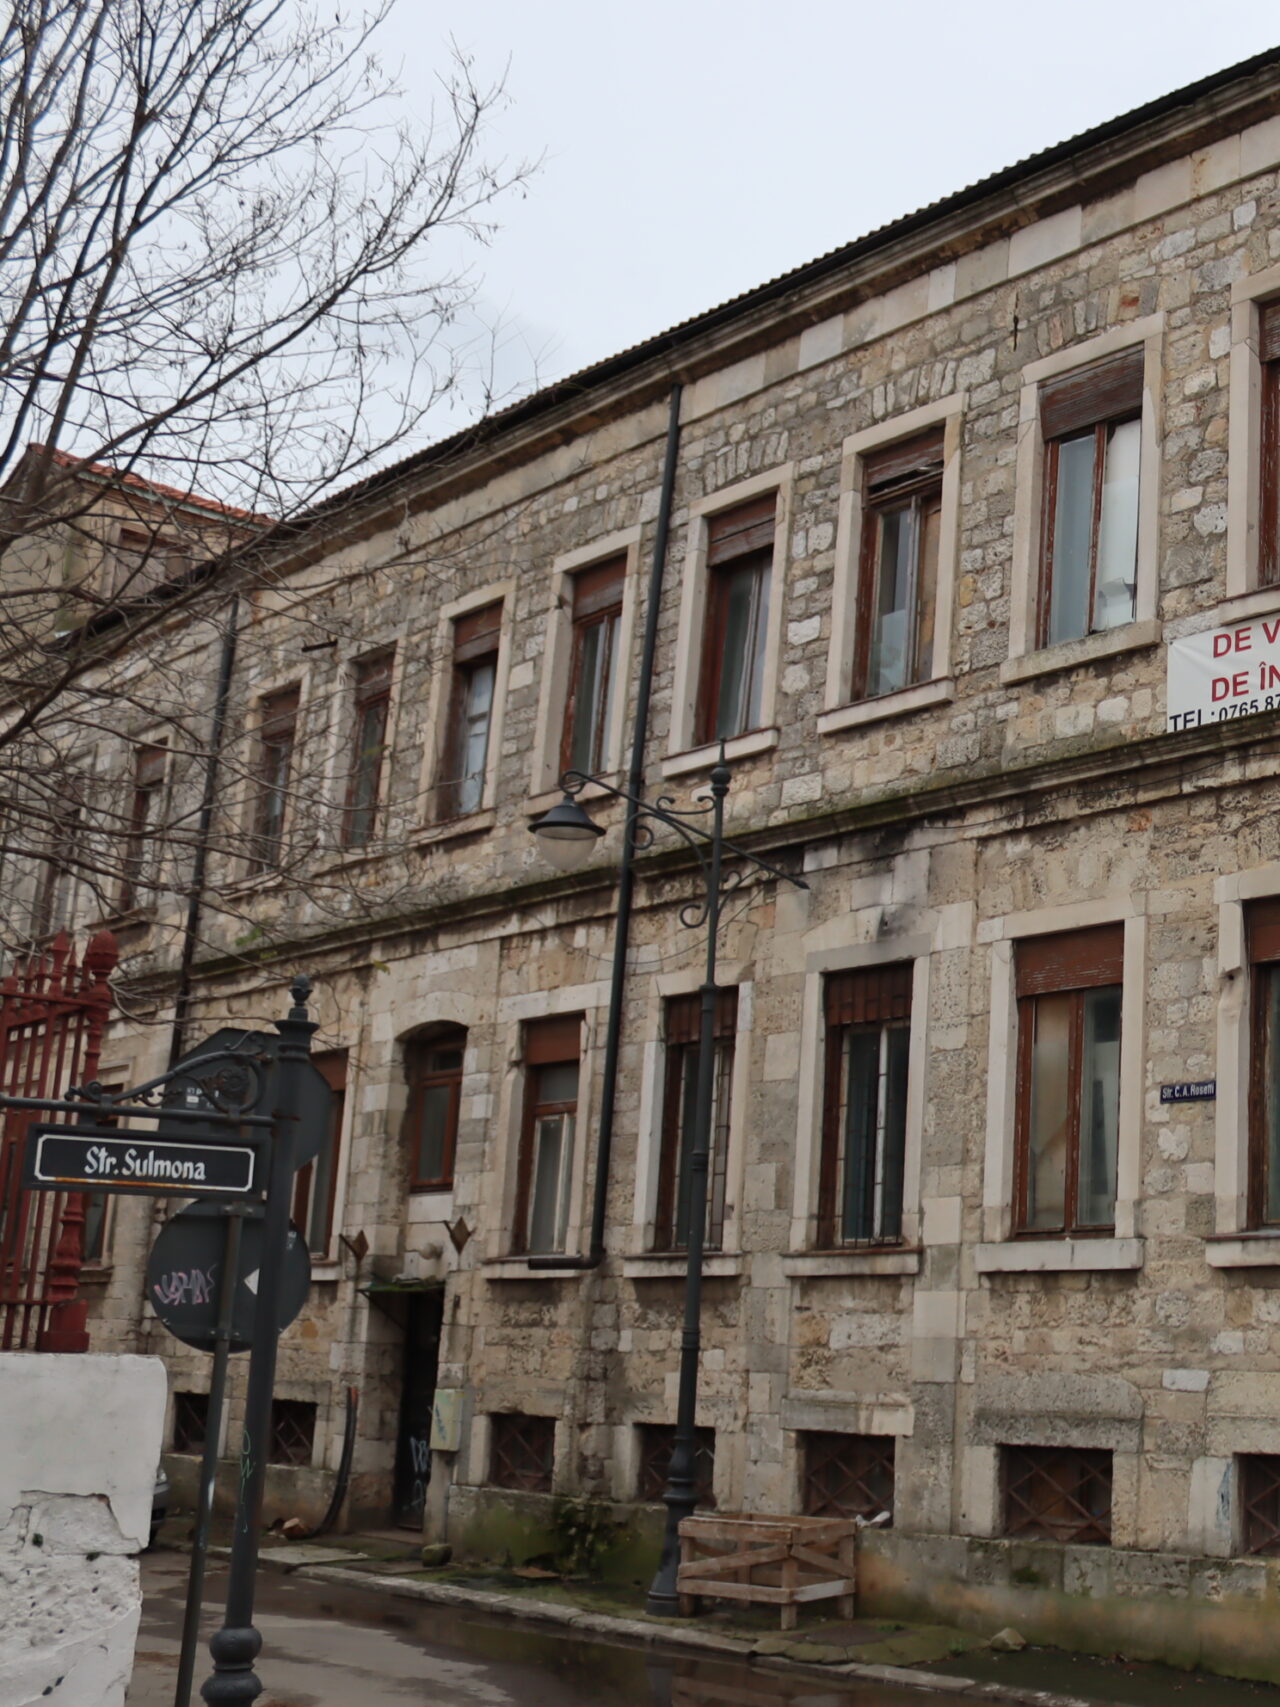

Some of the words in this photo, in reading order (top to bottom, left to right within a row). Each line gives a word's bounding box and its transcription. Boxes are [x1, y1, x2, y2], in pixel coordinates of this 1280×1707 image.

[1213, 626, 1252, 659] DE
[1211, 671, 1249, 703] DE
[121, 1148, 206, 1180] Sulmona
